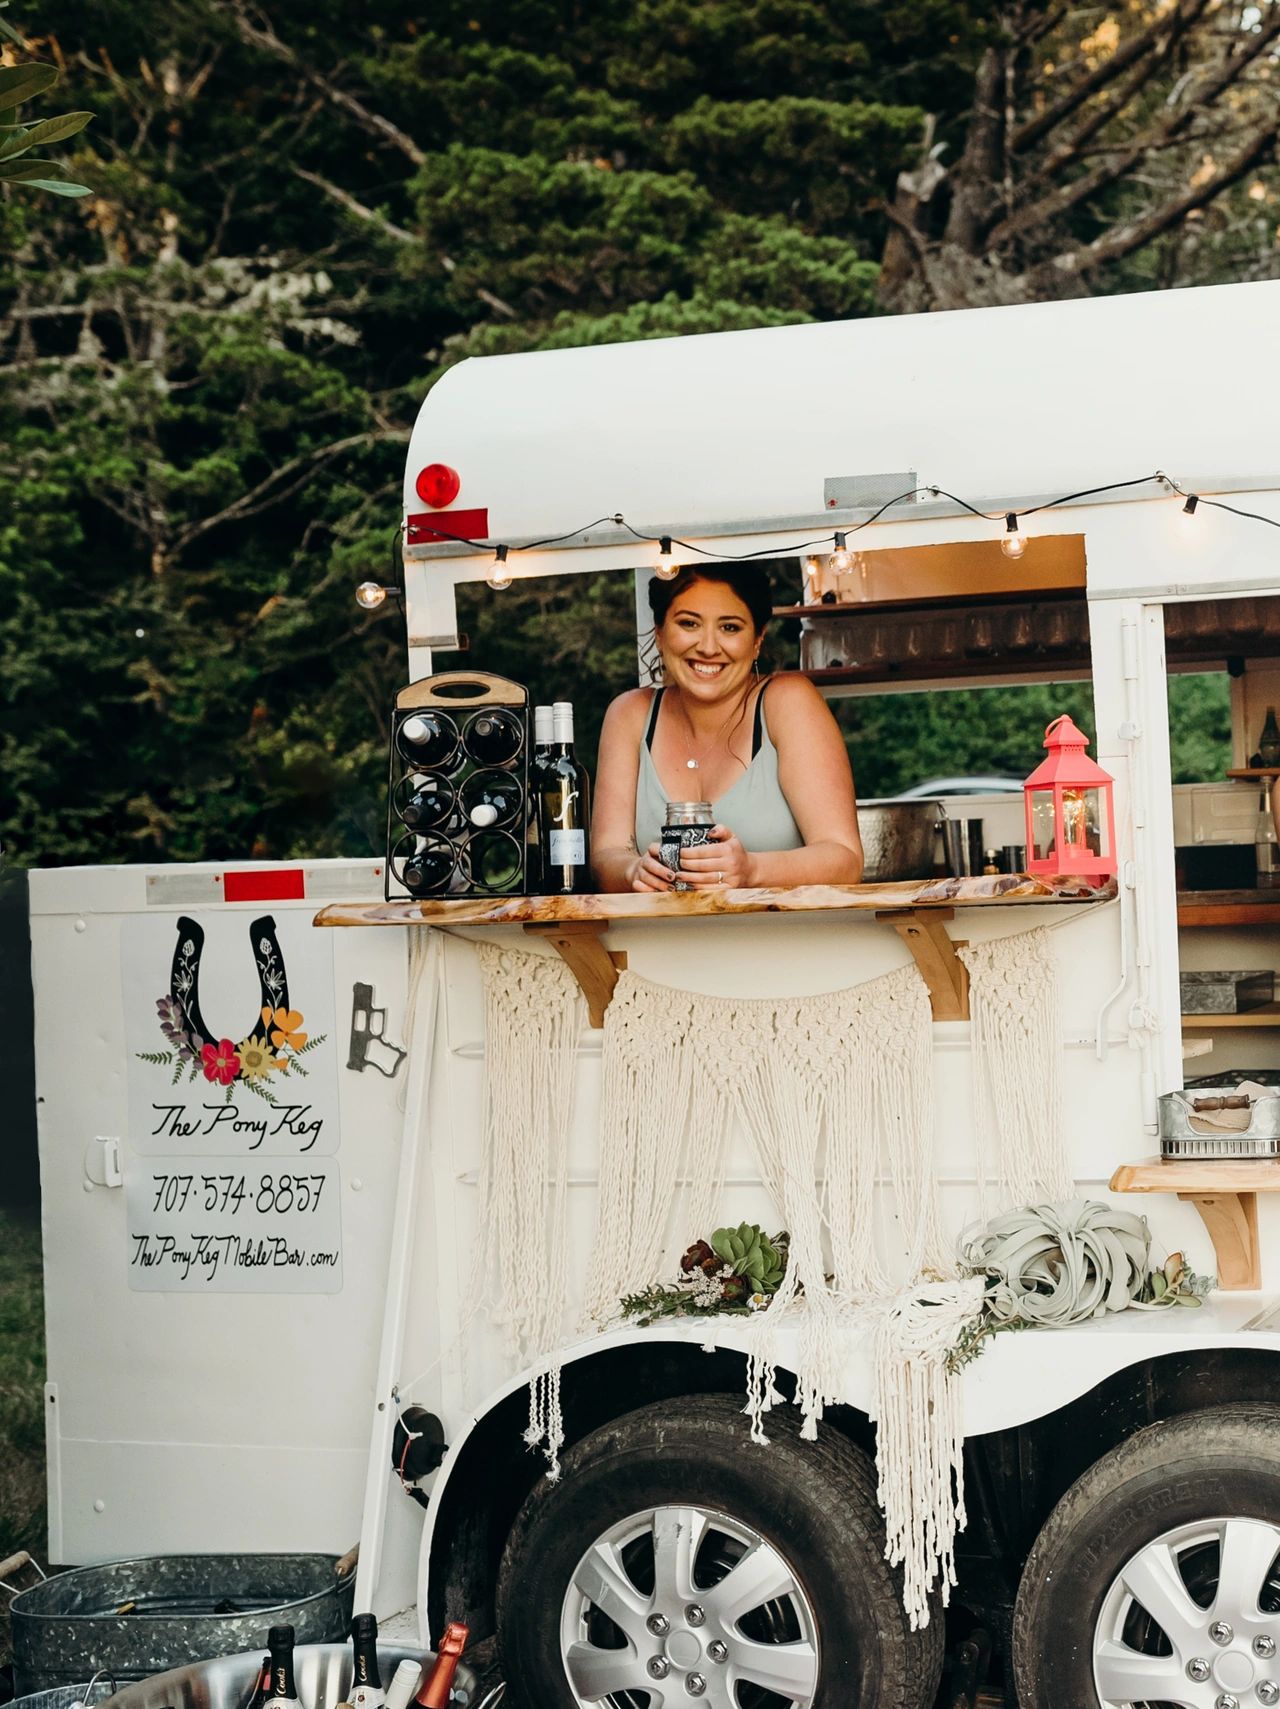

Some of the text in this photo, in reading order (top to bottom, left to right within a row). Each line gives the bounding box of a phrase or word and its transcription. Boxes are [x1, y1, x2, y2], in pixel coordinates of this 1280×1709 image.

[152, 1103, 323, 1152] The Pony Keg
